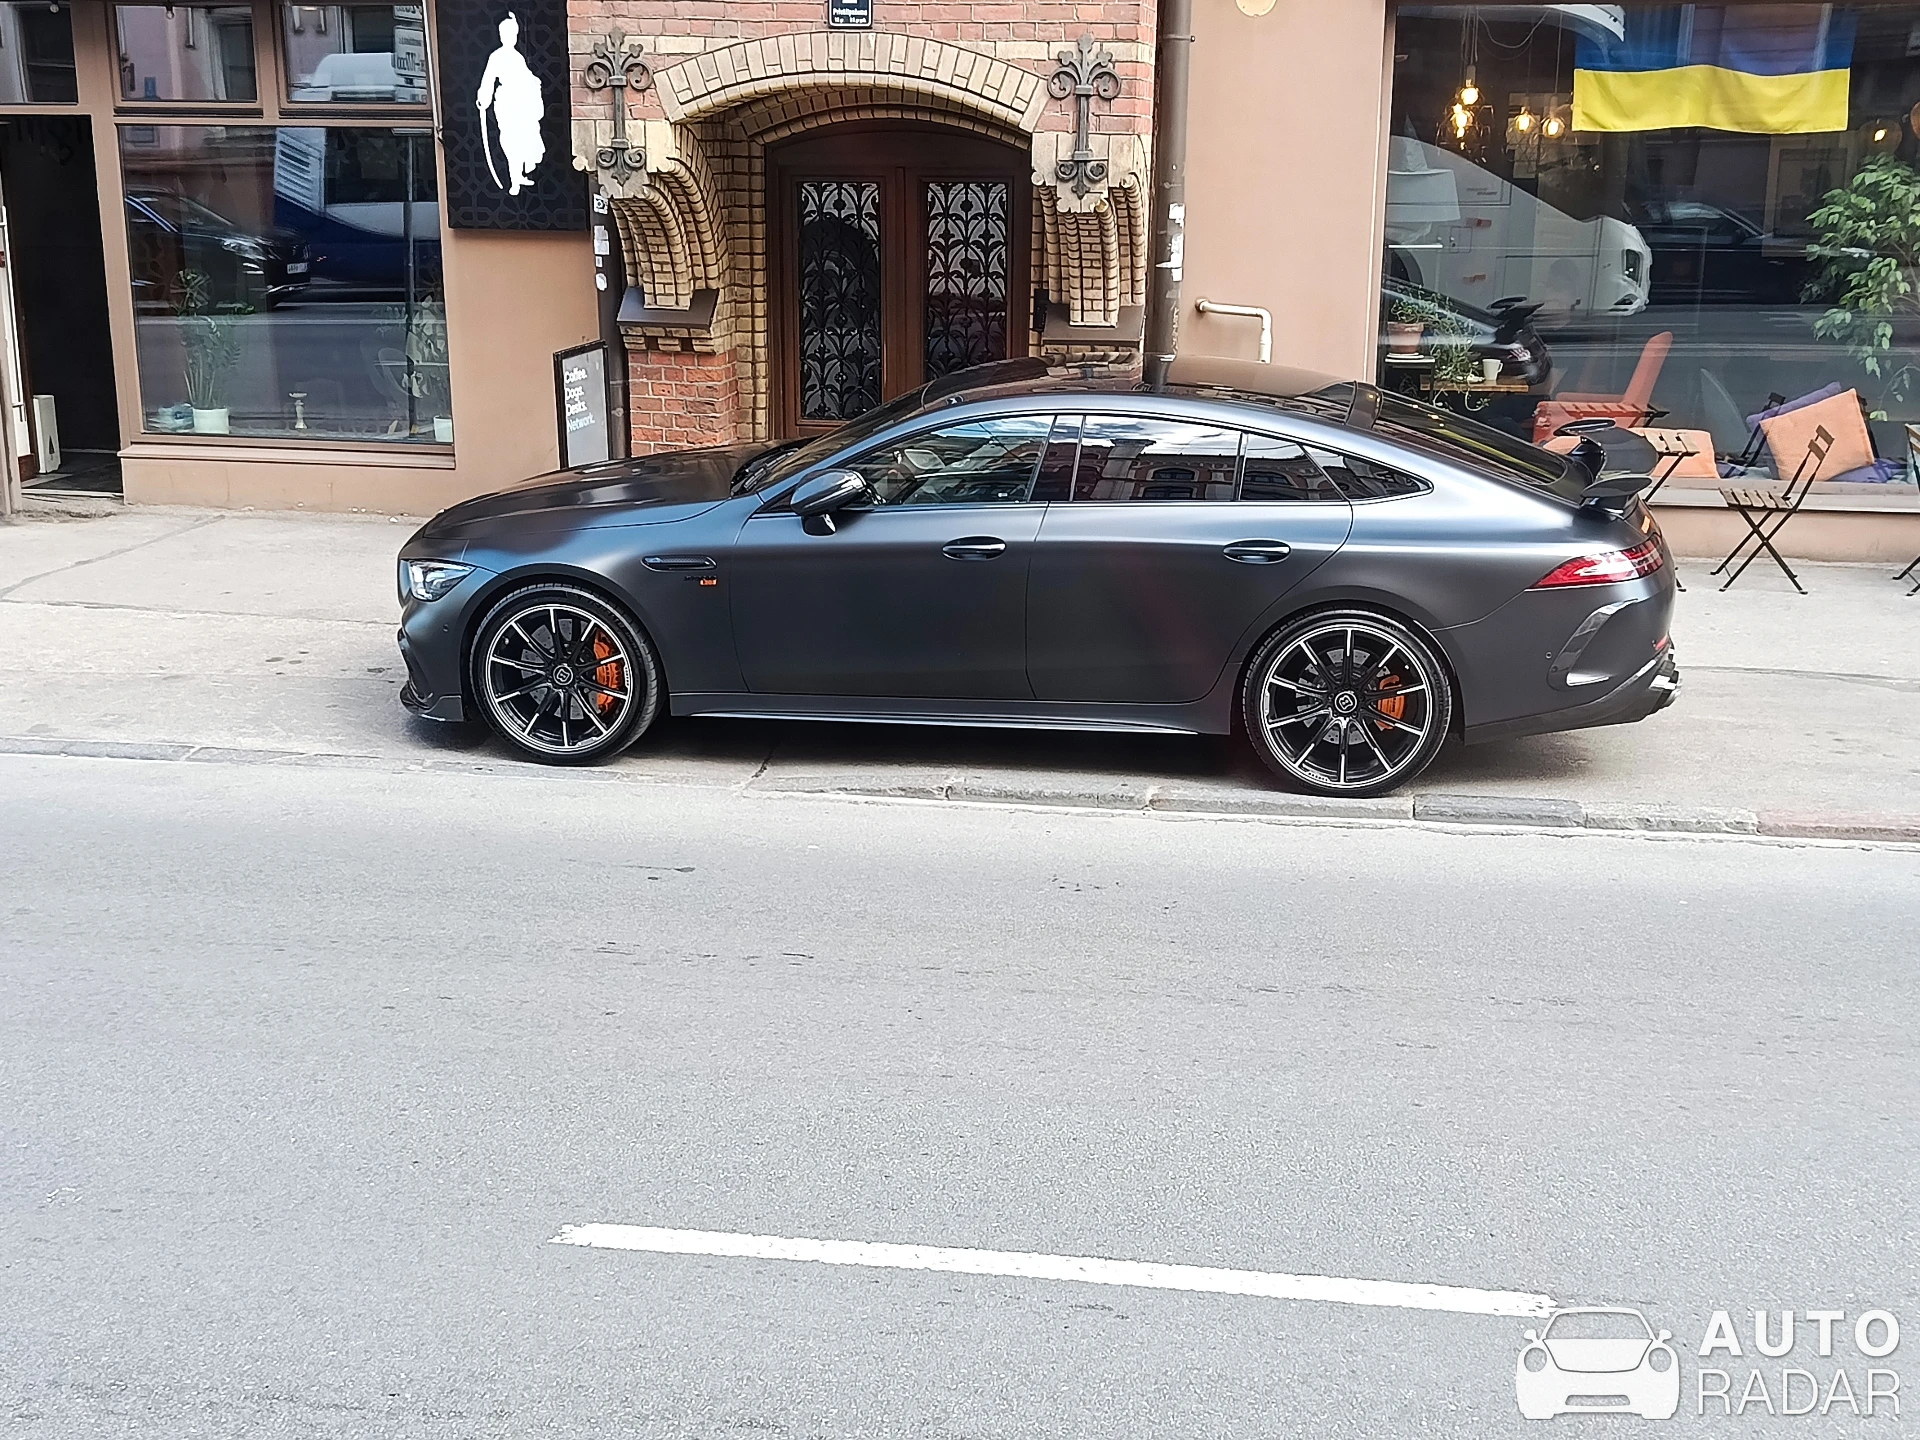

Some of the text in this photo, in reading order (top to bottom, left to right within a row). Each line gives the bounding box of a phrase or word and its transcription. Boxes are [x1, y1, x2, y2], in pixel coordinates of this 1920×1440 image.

[564, 367, 588, 384] Coffee.
[565, 386, 585, 401] Dogs.
[566, 401, 588, 417] Desks.
[567, 412, 596, 432] Network.
